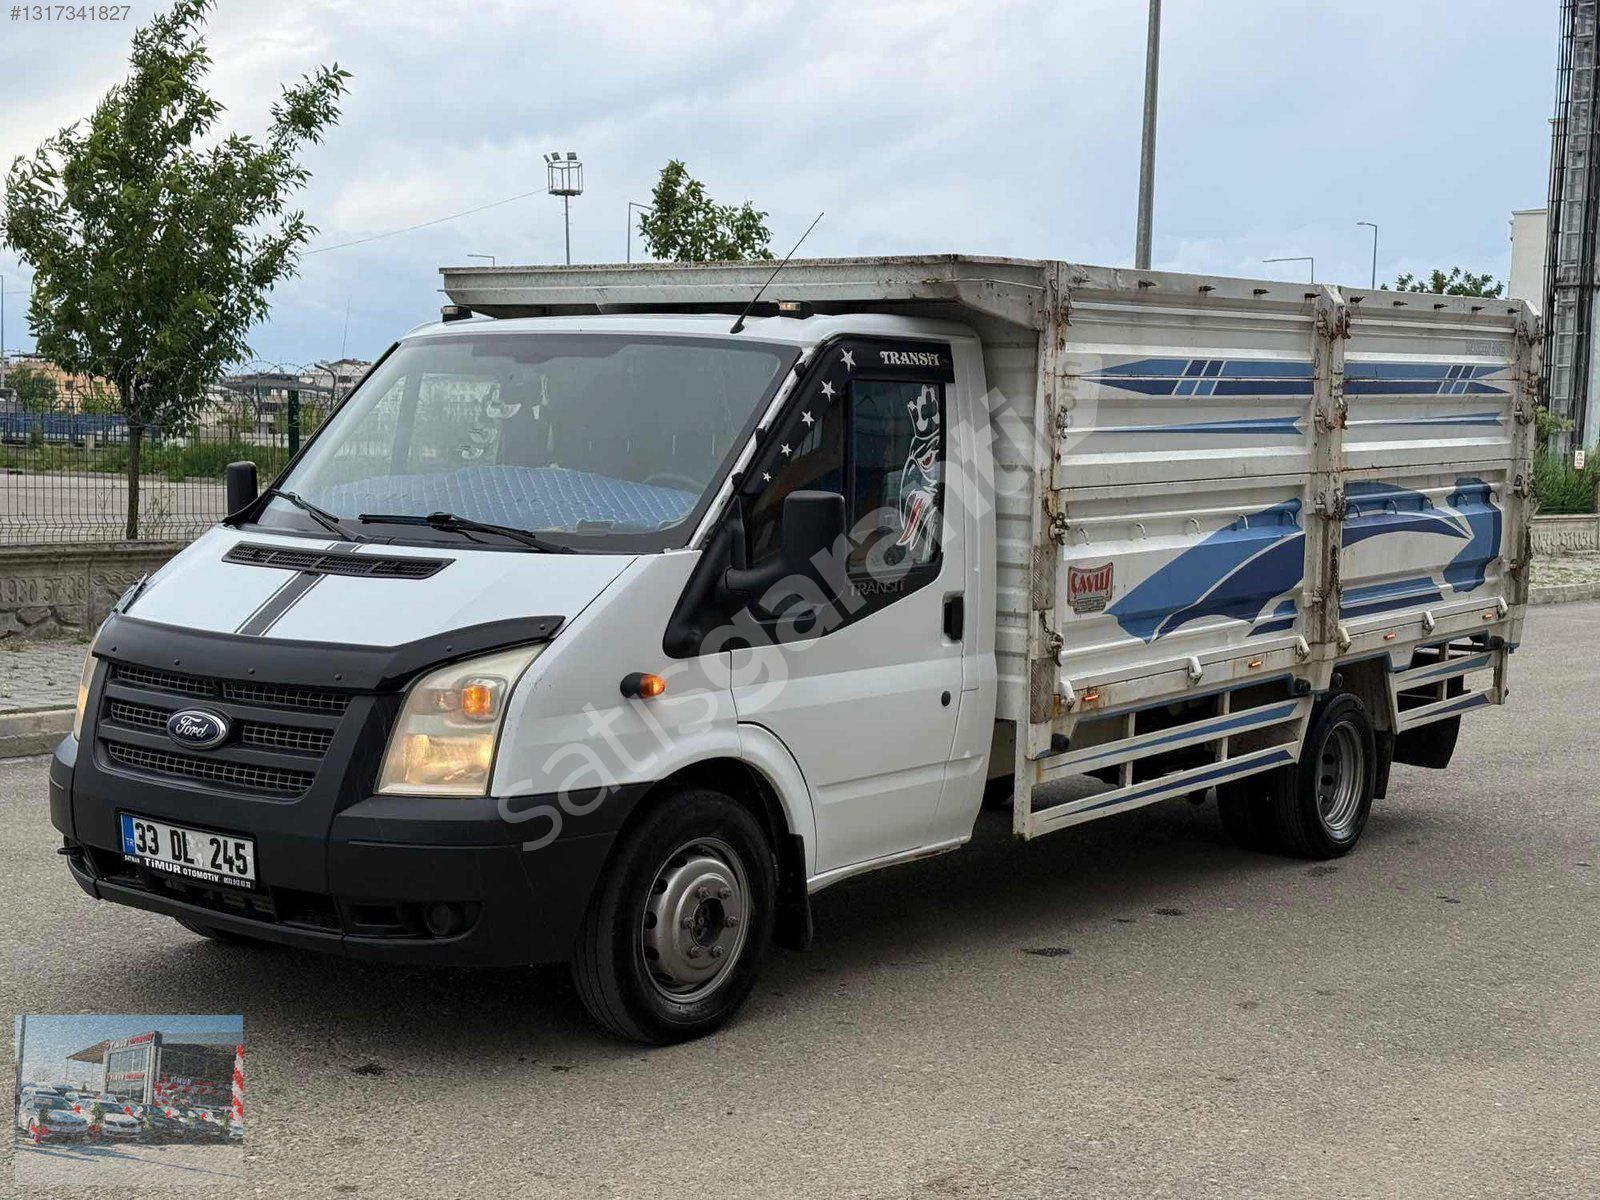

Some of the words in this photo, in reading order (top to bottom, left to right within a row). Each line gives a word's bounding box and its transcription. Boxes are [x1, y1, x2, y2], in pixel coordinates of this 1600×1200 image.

[176, 715, 209, 738] Ford
[135, 822, 159, 855] 33
[169, 829, 194, 864] DL
[209, 837, 248, 875] 245
